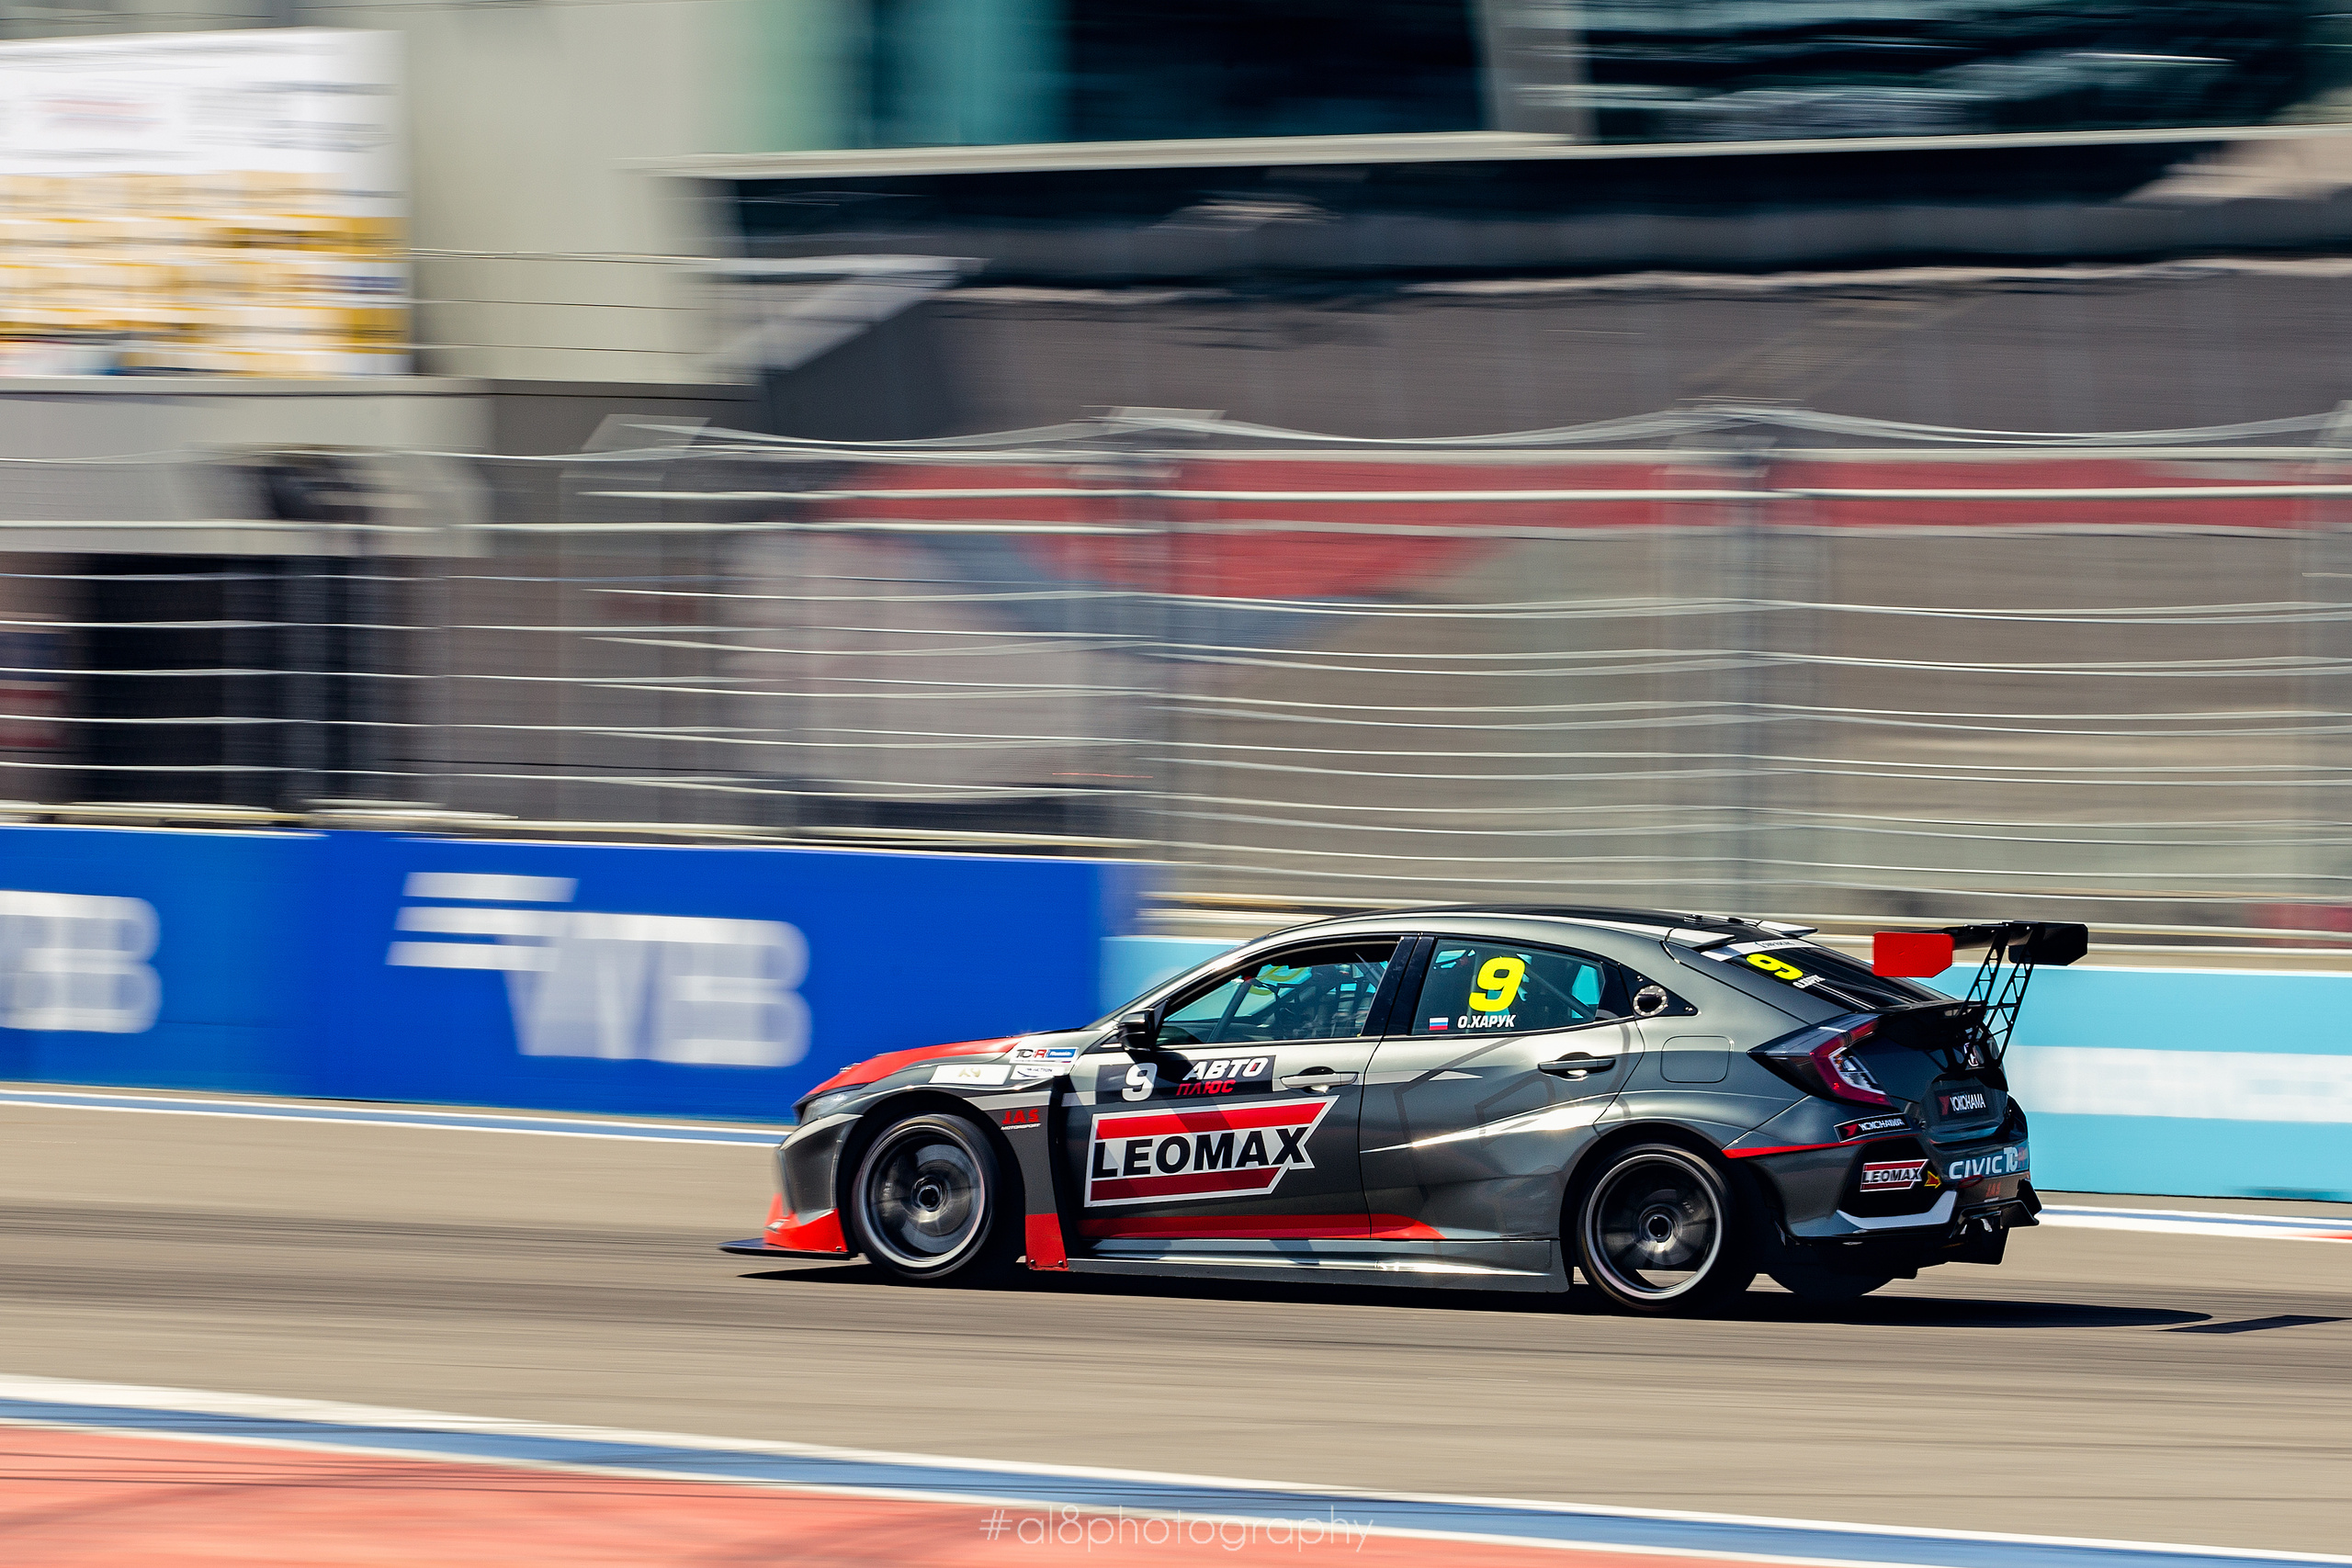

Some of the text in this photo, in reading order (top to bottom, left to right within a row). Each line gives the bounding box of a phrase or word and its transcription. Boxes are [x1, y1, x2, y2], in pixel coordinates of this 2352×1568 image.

[1747, 953, 1804, 980] 9
[1468, 957, 1526, 1011] 9
[1457, 1015, 1517, 1029] О.ХАРУК
[1182, 1057, 1269, 1081] АВТО
[1122, 1063, 1158, 1101] 9
[1176, 1079, 1237, 1096] ПЛЮС
[1950, 1093, 1986, 1112] YOKOHAMA
[1001, 1108, 1040, 1124] JAS
[1091, 1126, 1309, 1179] LEOMAX
[1862, 1168, 1923, 1183] LEOMAX
[1949, 1156, 2003, 1179] CIVIC
